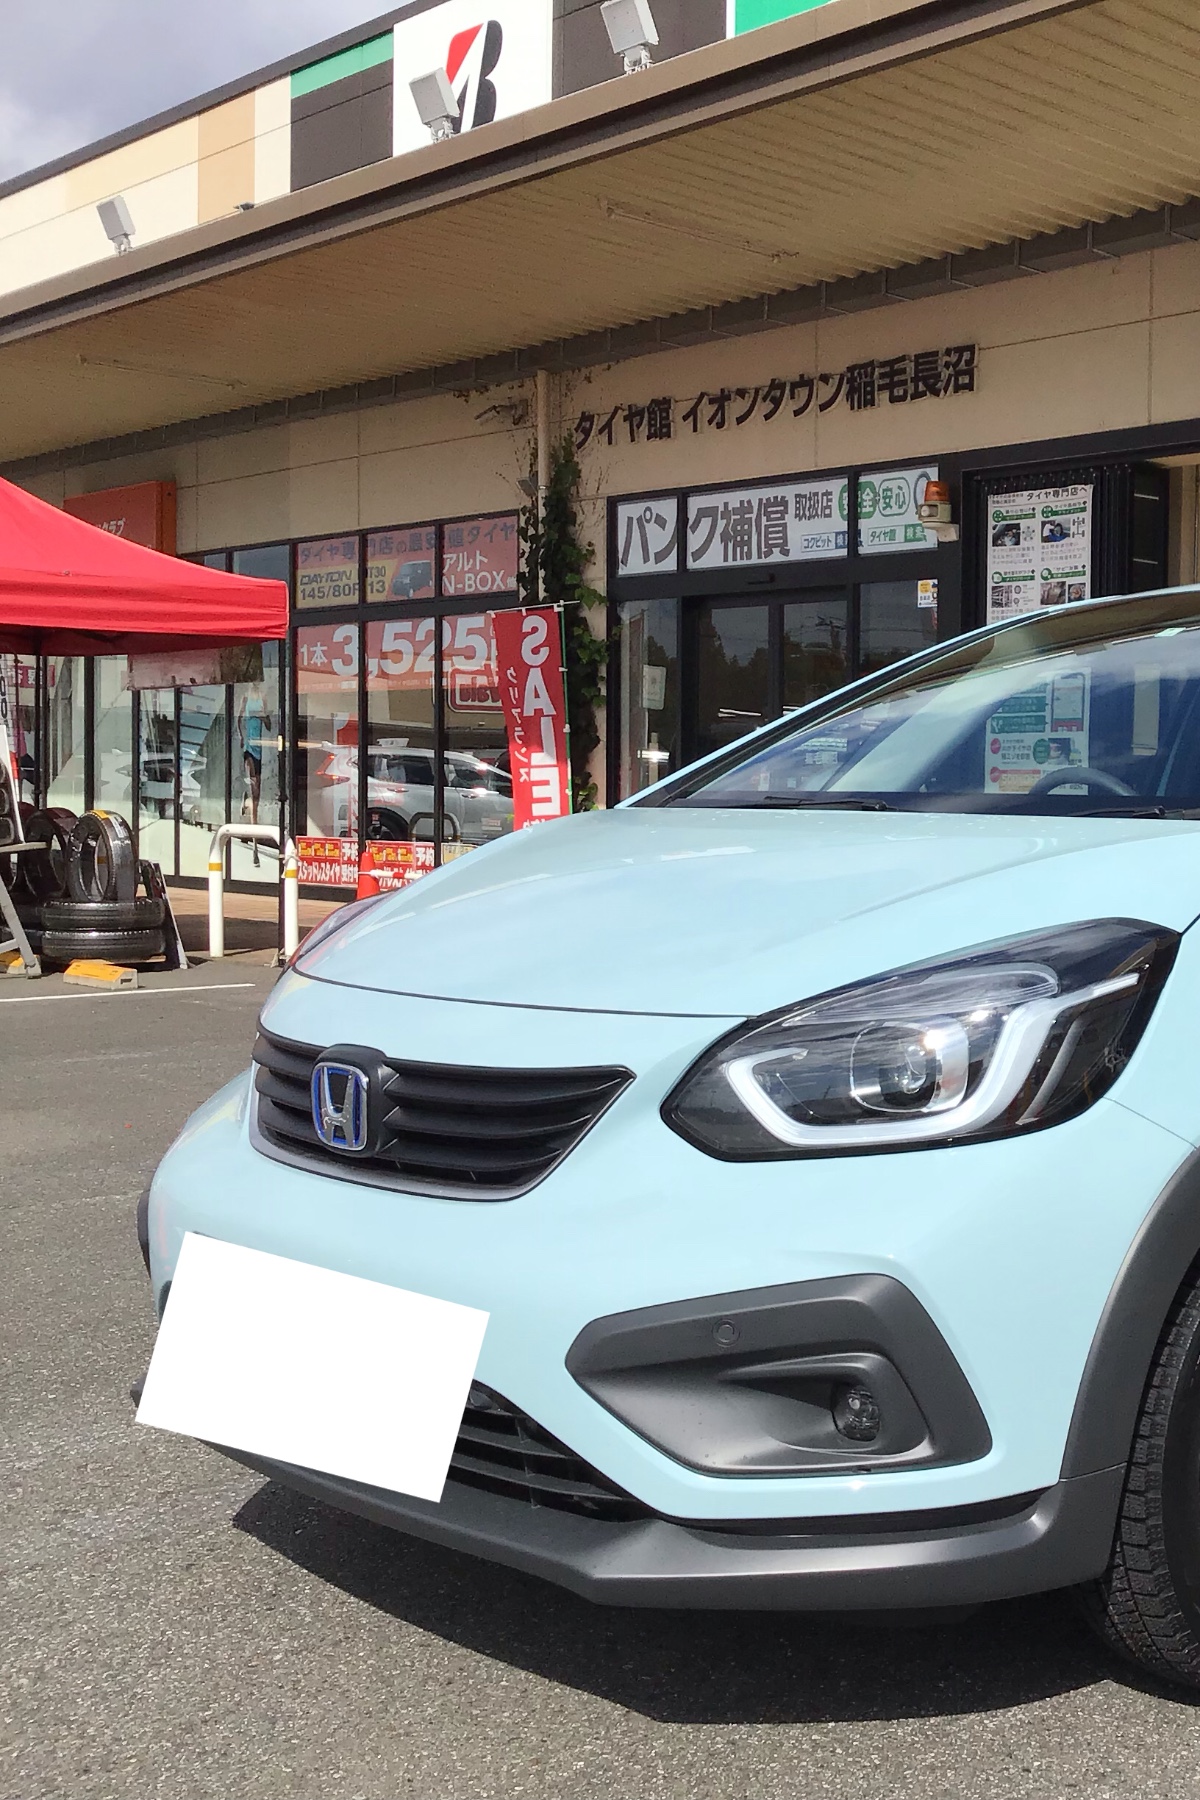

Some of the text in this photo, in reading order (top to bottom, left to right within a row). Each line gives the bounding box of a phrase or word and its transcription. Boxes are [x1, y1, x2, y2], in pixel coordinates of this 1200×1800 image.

[575, 344, 979, 450] タイヤ館 イオンタウン稲毛長沼
[621, 495, 790, 568] パンク補償
[794, 489, 833, 521] 取扱店
[881, 486, 907, 512] 安心
[869, 528, 897, 543] タイヤ館
[443, 550, 488, 573] アルト
[443, 570, 505, 594] N-BOX
[300, 642, 328, 667] 1本
[332, 616, 488, 678] 3,525
